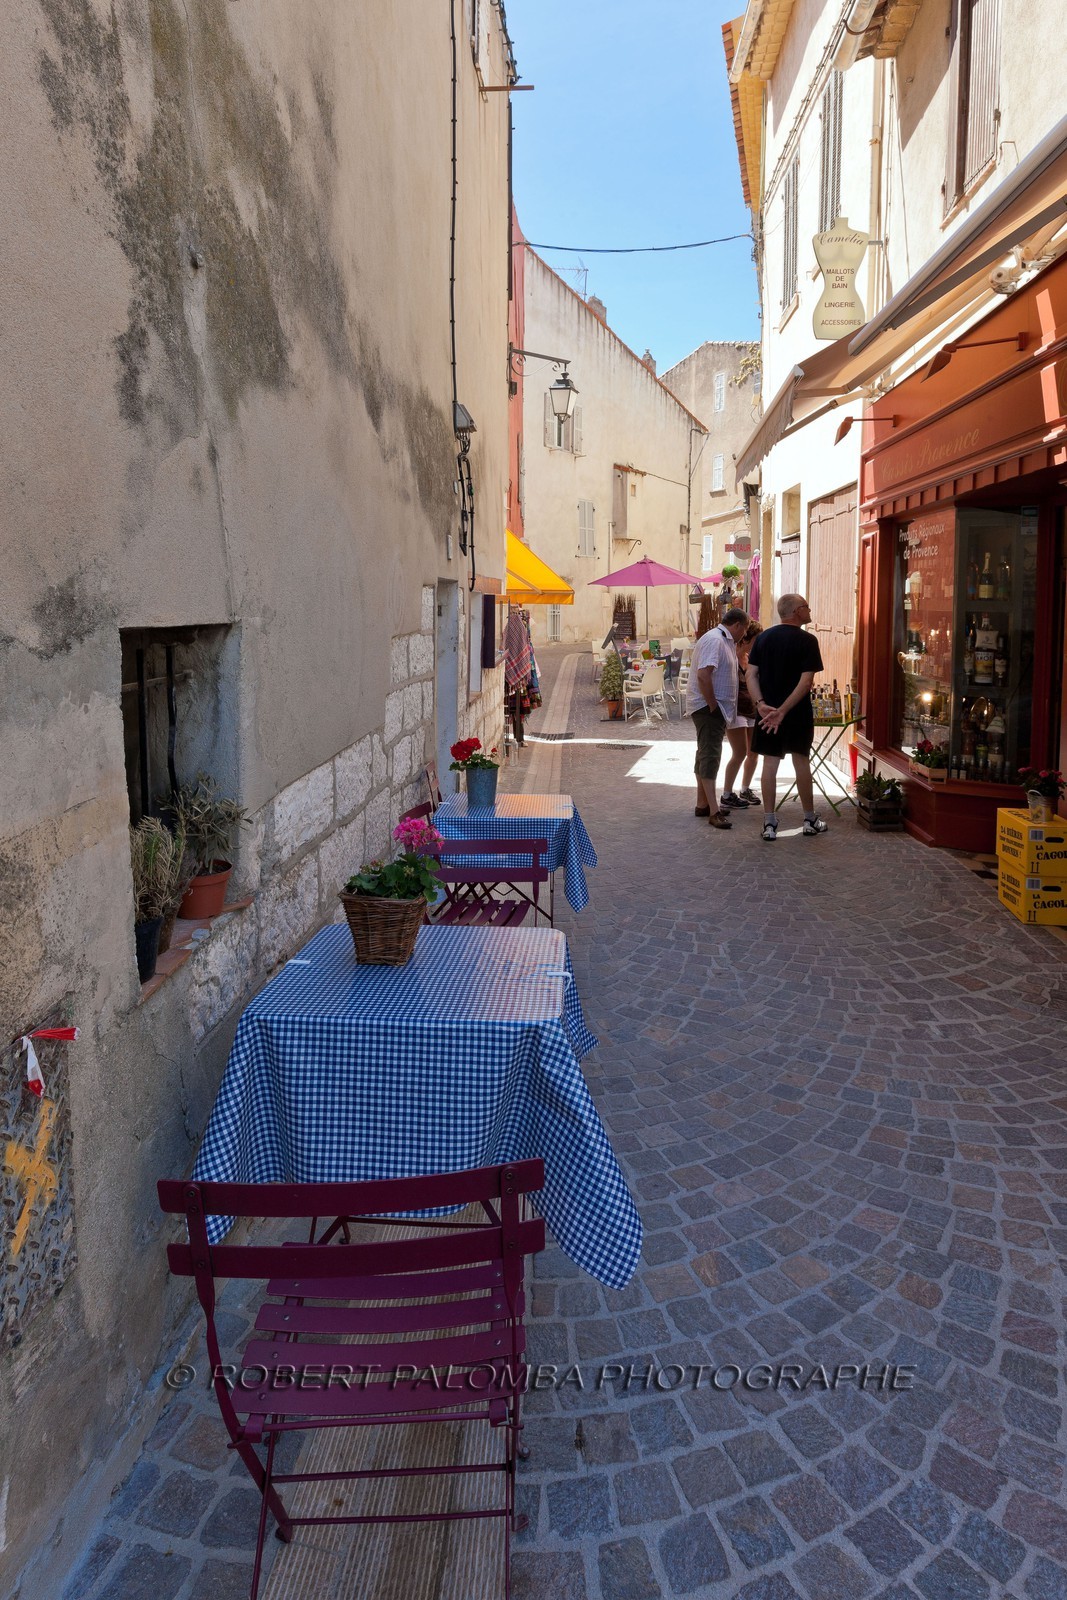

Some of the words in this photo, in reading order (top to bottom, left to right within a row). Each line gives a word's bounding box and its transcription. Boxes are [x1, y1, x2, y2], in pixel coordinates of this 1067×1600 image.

[818, 233, 864, 246] Camélia
[881, 453, 914, 481] Cassis
[917, 428, 980, 468] Provence
[899, 528, 918, 543] Produits
[919, 522, 946, 541] Régionaux
[903, 546, 911, 560] de
[911, 544, 939, 559] Provence
